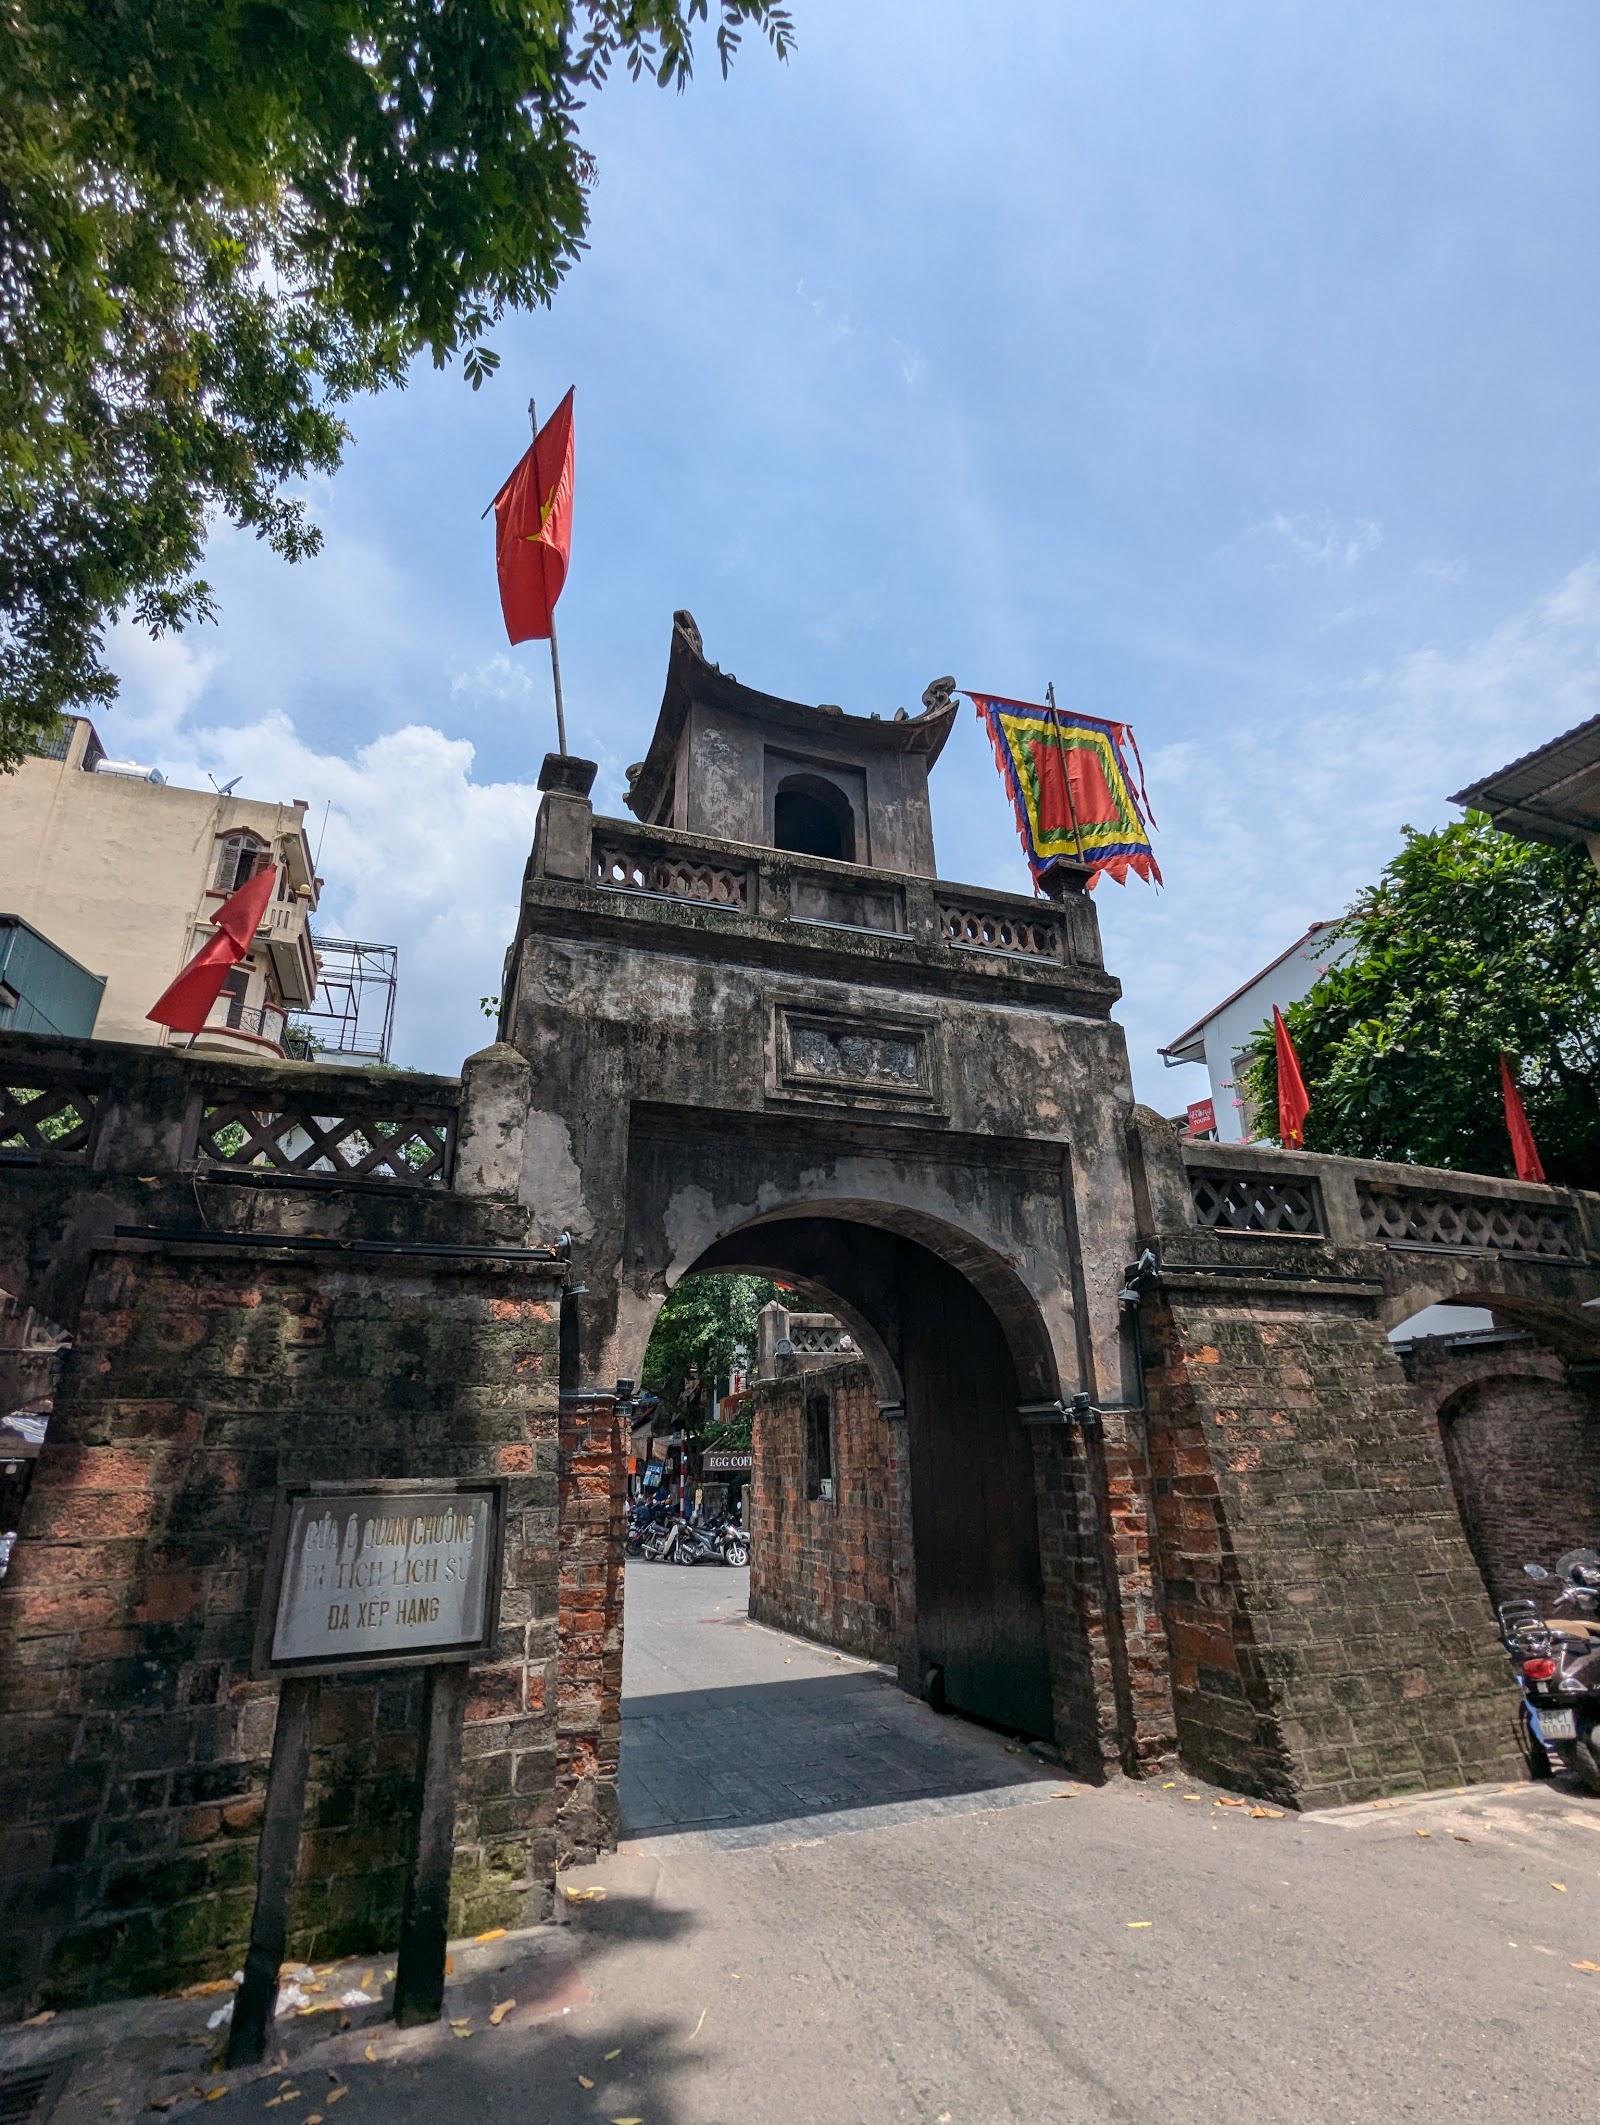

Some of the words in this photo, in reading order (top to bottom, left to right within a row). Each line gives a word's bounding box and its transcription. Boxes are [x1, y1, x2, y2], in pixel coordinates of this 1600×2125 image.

[1193, 1115, 1211, 1125] TOURS
[709, 1456, 729, 1467] EGG
[396, 1597, 440, 1627] HẠNG
